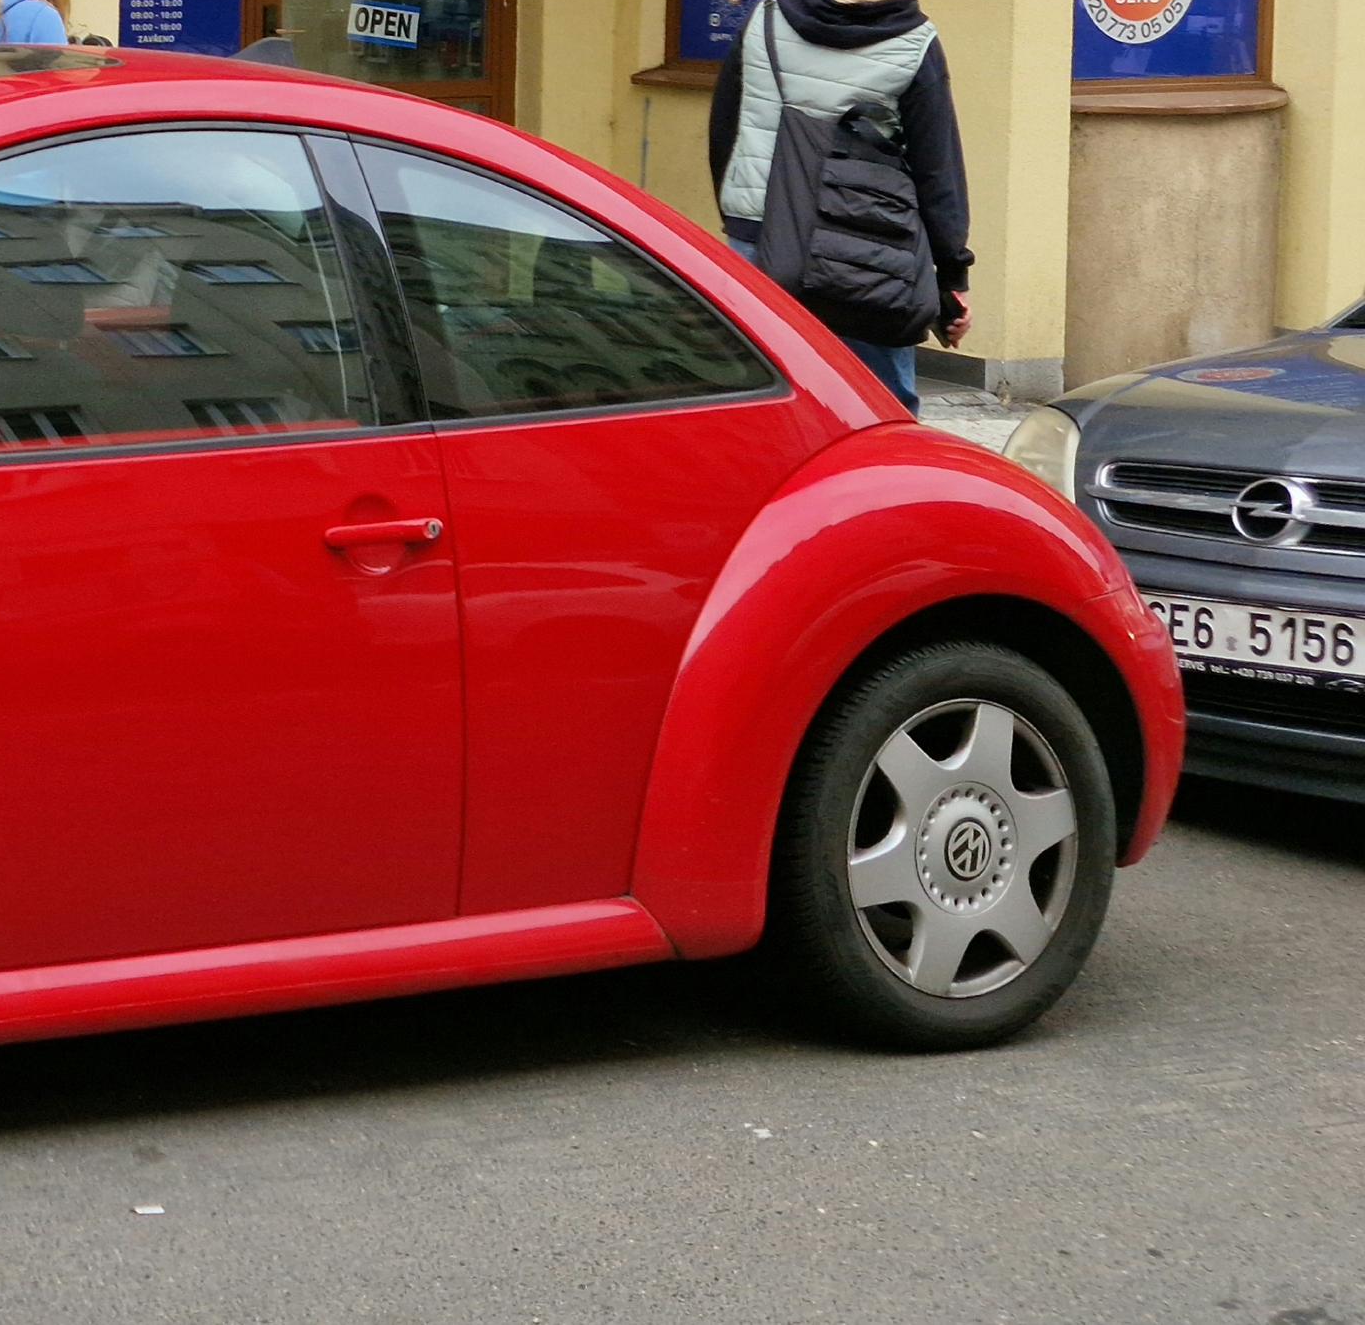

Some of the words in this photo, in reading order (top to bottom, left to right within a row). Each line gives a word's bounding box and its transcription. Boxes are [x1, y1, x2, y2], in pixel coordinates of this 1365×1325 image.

[355, 7, 412, 39] OPEN
[1106, 17, 1137, 41] 773
[1141, 18, 1162, 39] 05
[1162, 0, 1184, 24] 05
[1249, 612, 1354, 666] 5156
